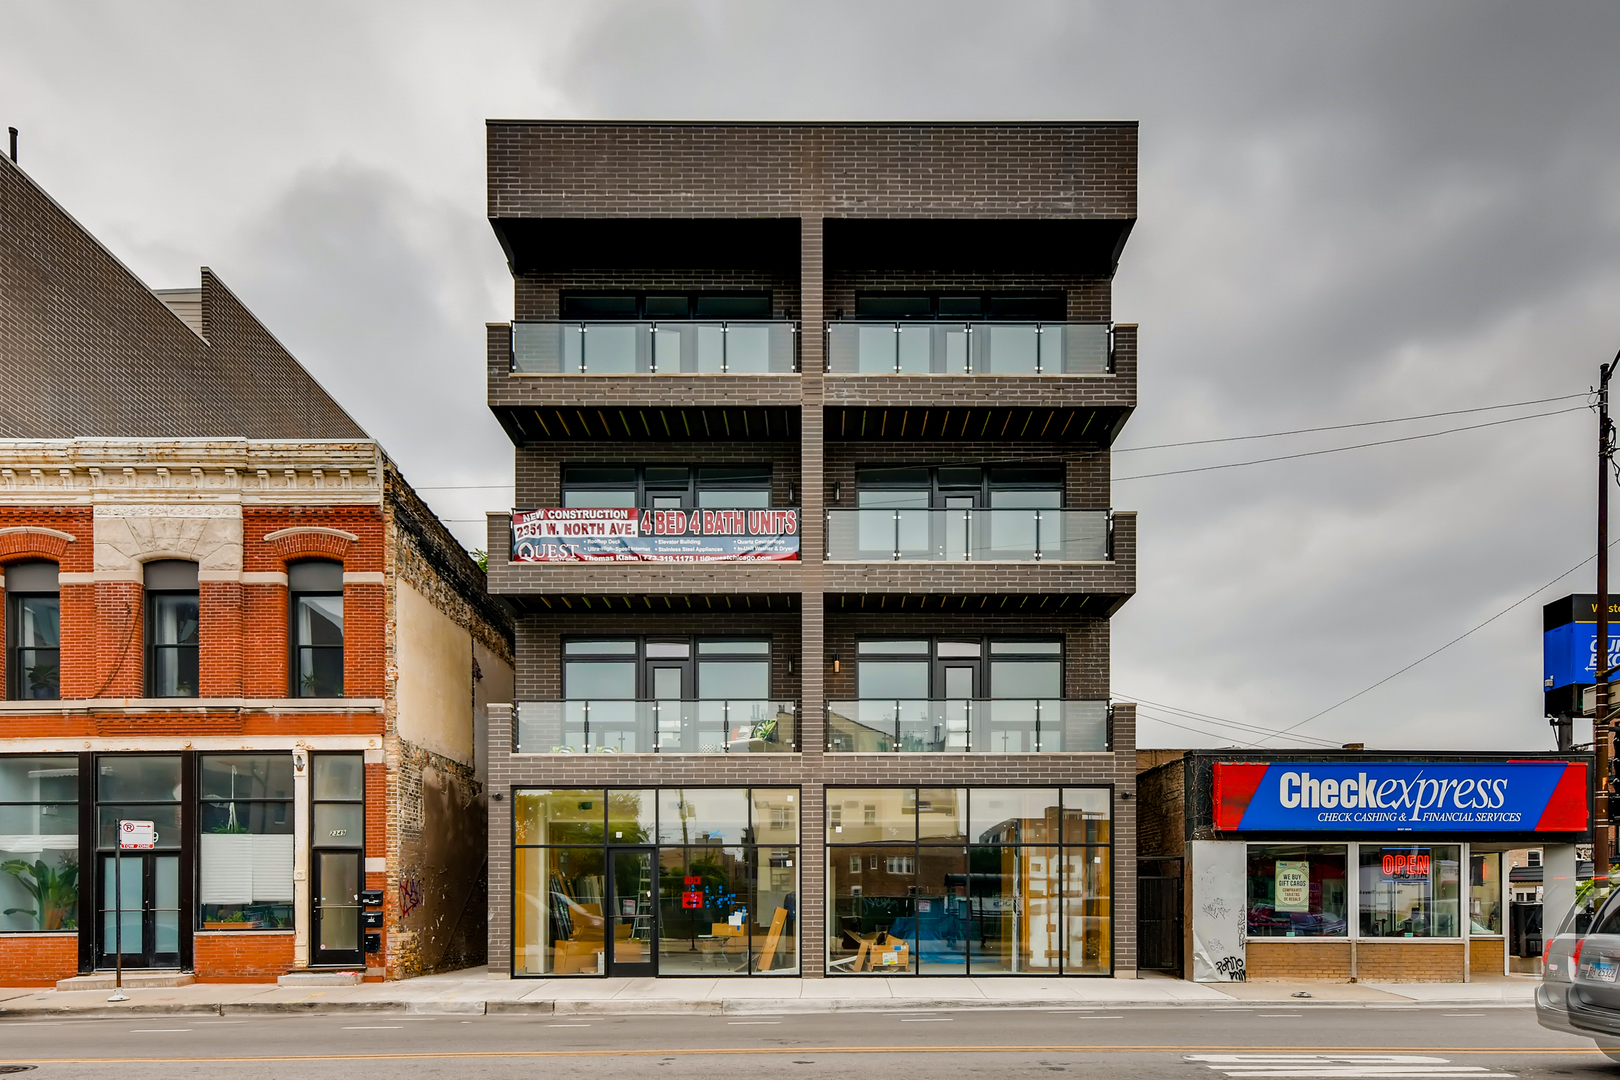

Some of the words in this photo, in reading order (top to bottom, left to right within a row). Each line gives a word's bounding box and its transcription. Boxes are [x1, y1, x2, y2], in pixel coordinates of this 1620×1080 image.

[523, 510, 544, 522] NEW
[548, 510, 628, 520] CONSTRUCTION
[640, 510, 652, 535] 4
[654, 510, 687, 535] BED
[689, 510, 700, 535] 4
[702, 510, 746, 535] BATH
[748, 510, 797, 535] UNITS
[516, 523, 542, 539] 2351
[546, 523, 560, 535] W.
[564, 523, 604, 535] NORTH
[609, 523, 636, 535] AVE.
[518, 542, 580, 562] QUEST
[1318, 812, 1352, 822] CHECK
[1353, 812, 1397, 822] CASHING
[1398, 812, 1407, 822] &
[1422, 812, 1473, 822] FINANCIAL
[1475, 812, 1522, 822] SERVICES
[1382, 854, 1430, 875] OPEN
